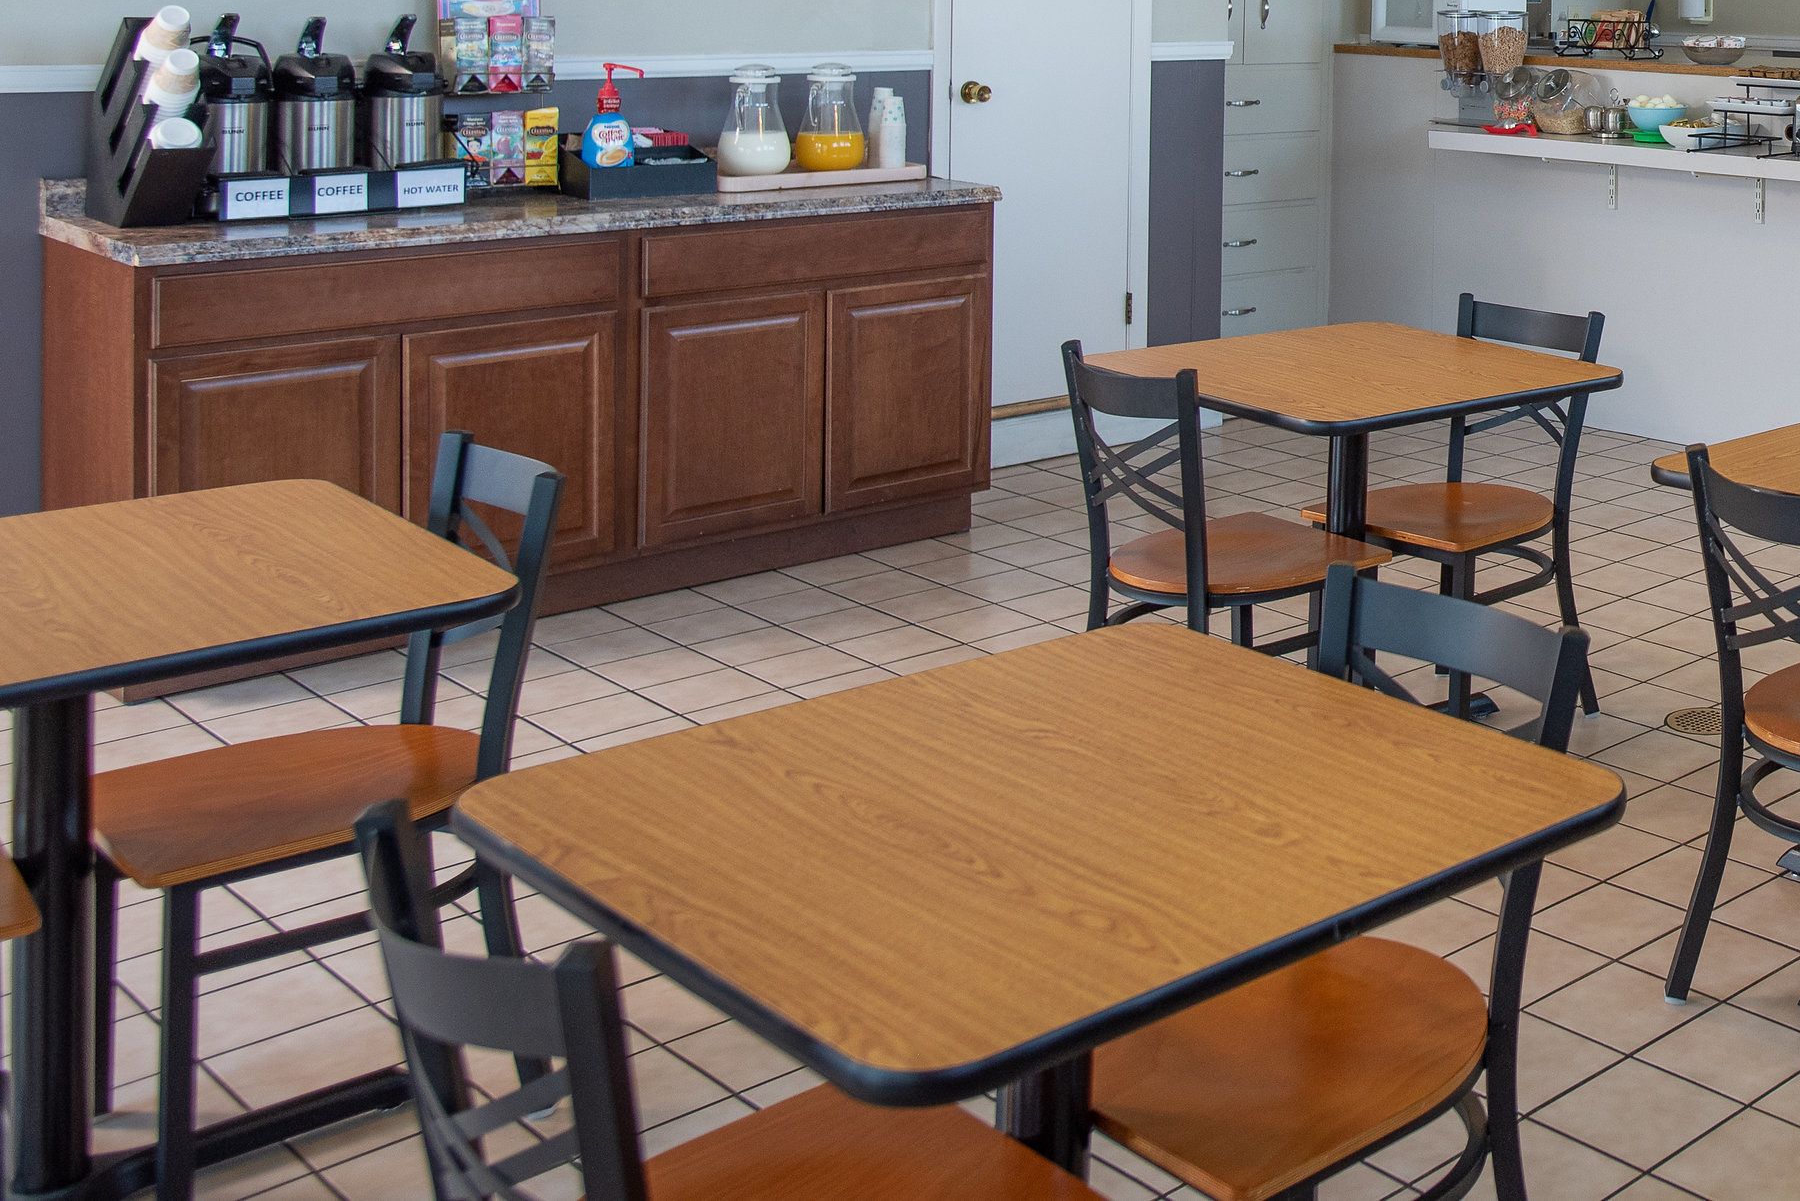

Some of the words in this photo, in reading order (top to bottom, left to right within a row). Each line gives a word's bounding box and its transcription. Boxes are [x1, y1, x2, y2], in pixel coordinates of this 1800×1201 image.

[235, 189, 284, 202] COFFEE
[317, 184, 363, 197] COFFEE
[403, 186, 423, 195] HOT
[425, 184, 459, 194] WATER
